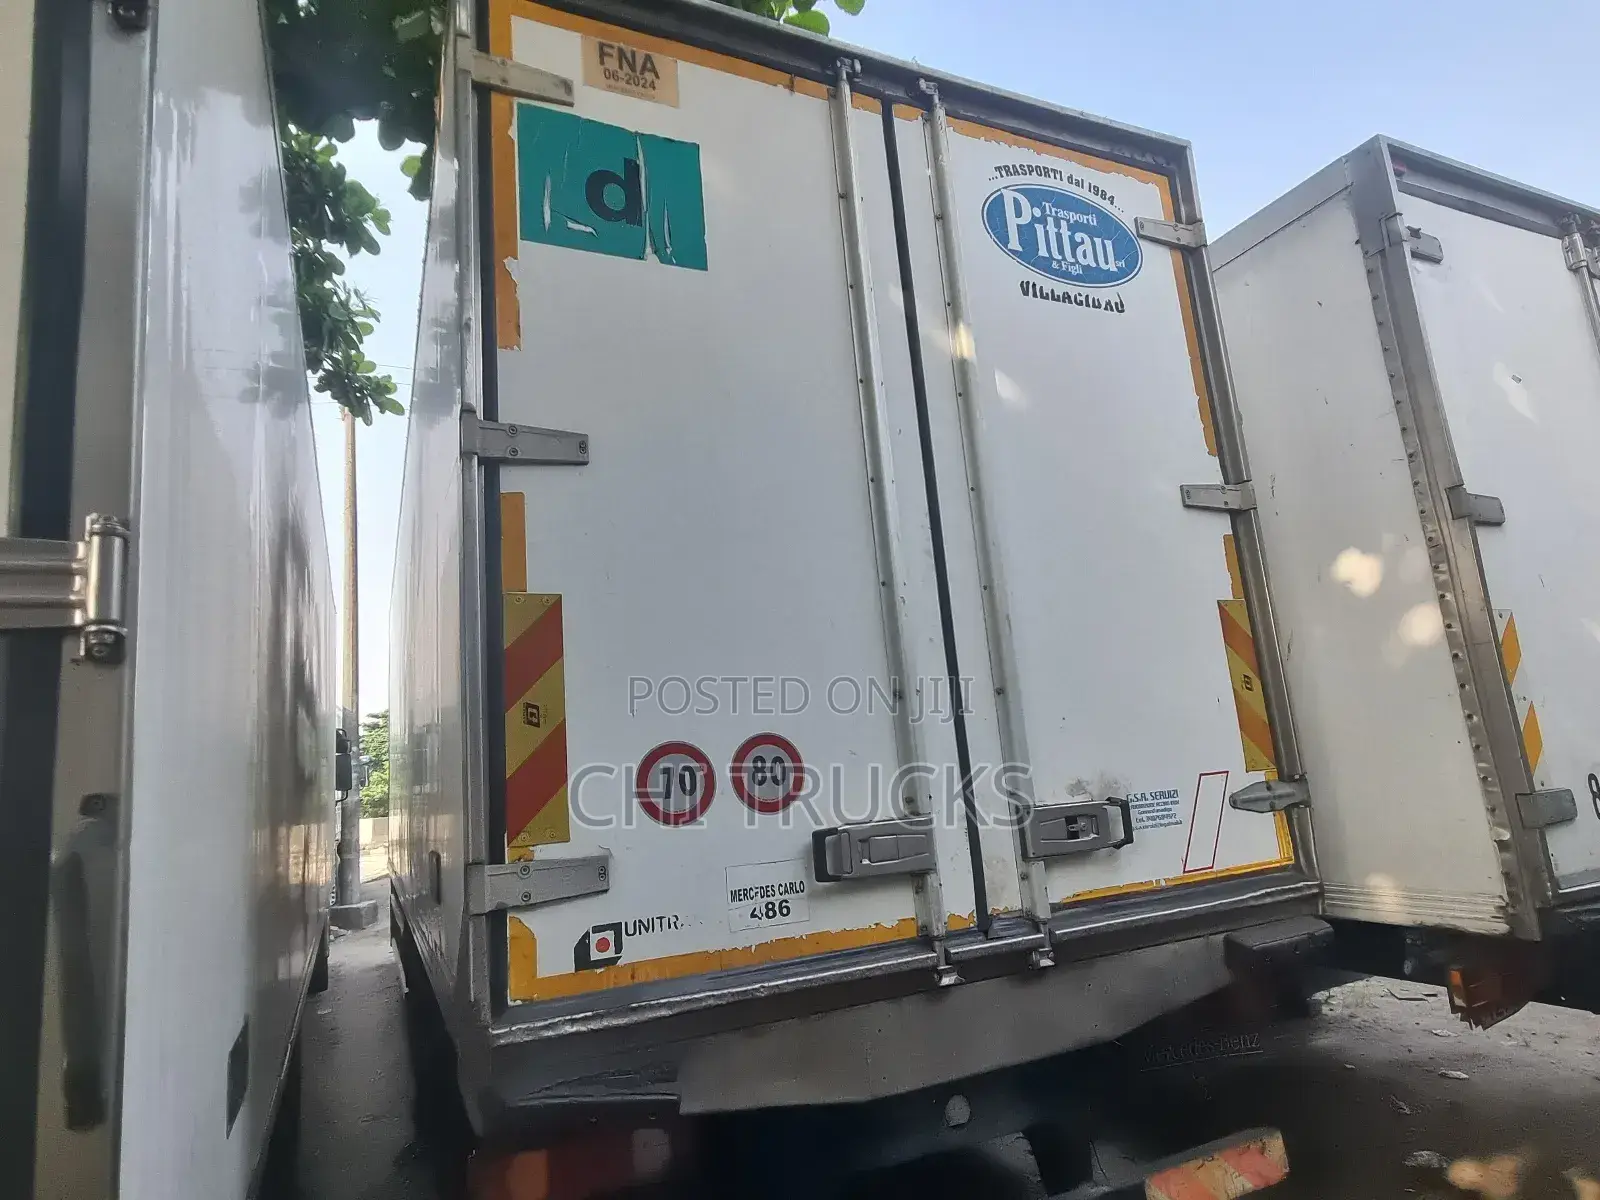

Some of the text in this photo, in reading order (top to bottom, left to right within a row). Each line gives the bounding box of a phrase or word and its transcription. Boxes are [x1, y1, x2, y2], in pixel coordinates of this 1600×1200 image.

[598, 41, 660, 80] FNA
[603, 68, 656, 91] 06-2024
[1067, 174, 1084, 189] dal
[1042, 202, 1098, 226] Trasporti
[1001, 188, 1118, 272] Pittau
[1062, 260, 1083, 275] Figli
[752, 755, 787, 787] 80
[730, 880, 805, 903] MERCEDES CARLO
[750, 899, 791, 921] 486
